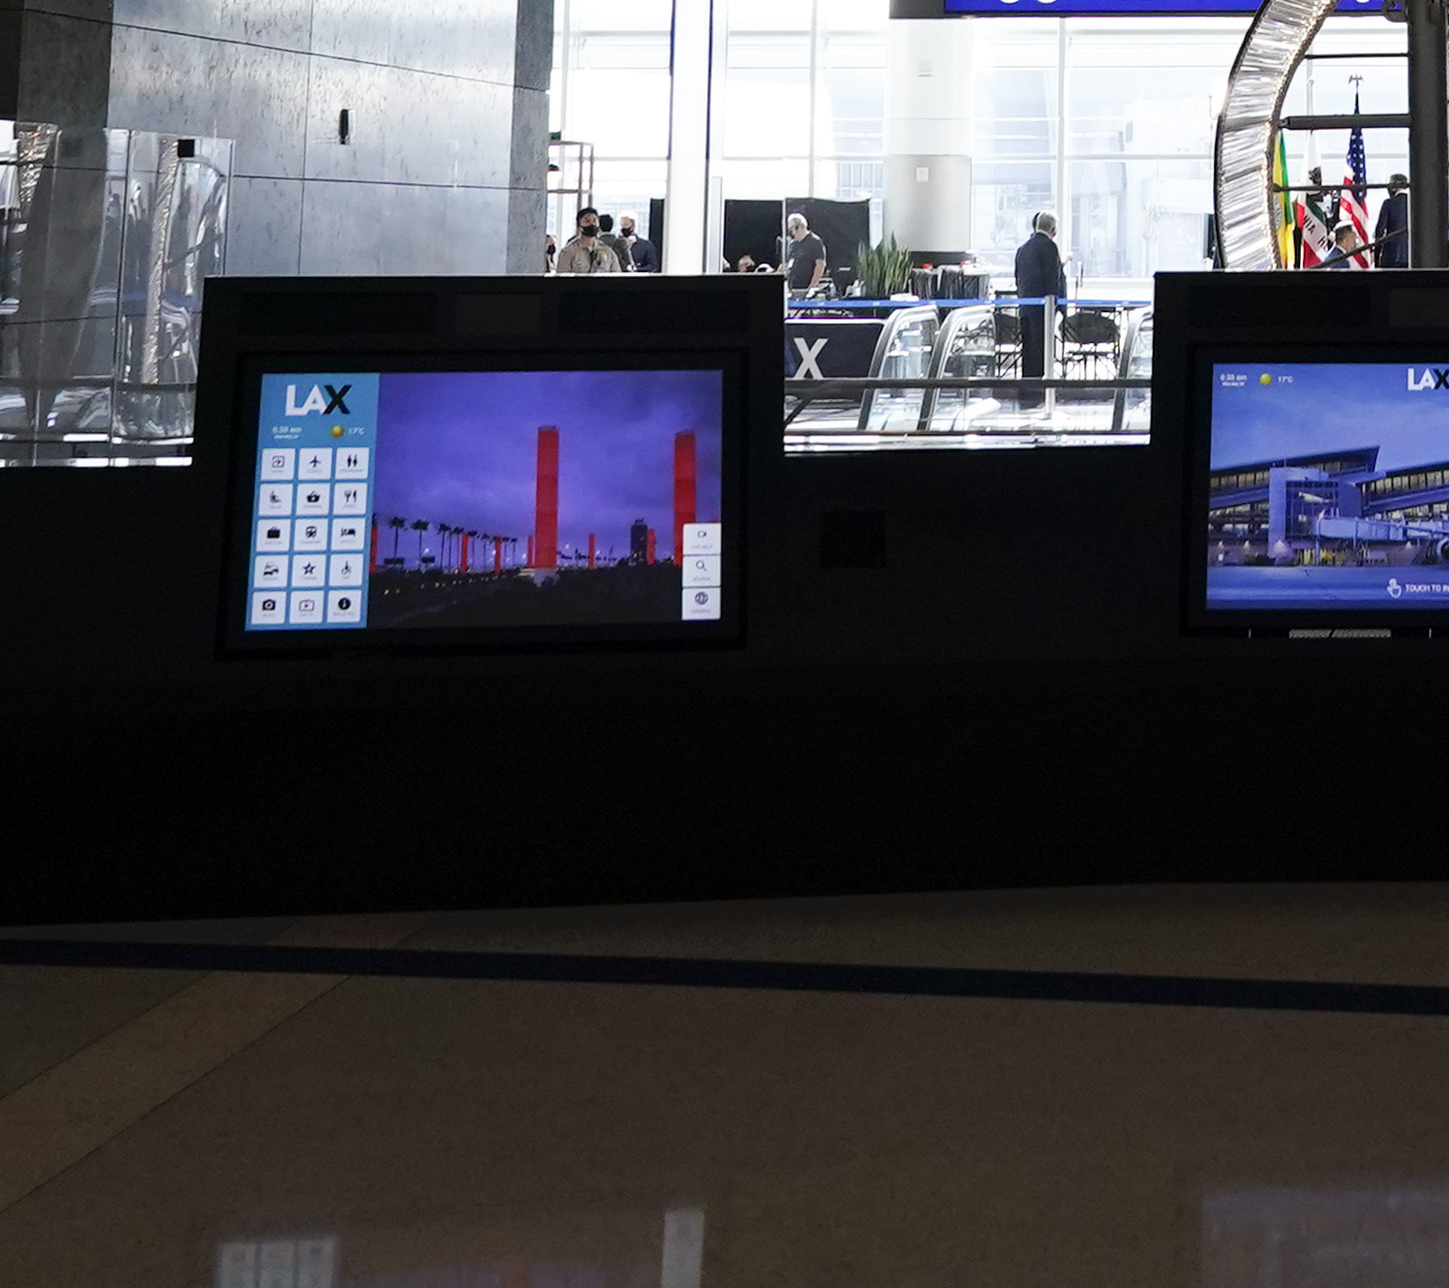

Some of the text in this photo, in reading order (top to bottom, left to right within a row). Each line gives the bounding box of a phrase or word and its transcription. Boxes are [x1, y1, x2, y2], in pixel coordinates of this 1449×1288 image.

[284, 384, 353, 417] LAX
[1405, 583, 1430, 593] TOUCH
[1431, 583, 1442, 593] TO
